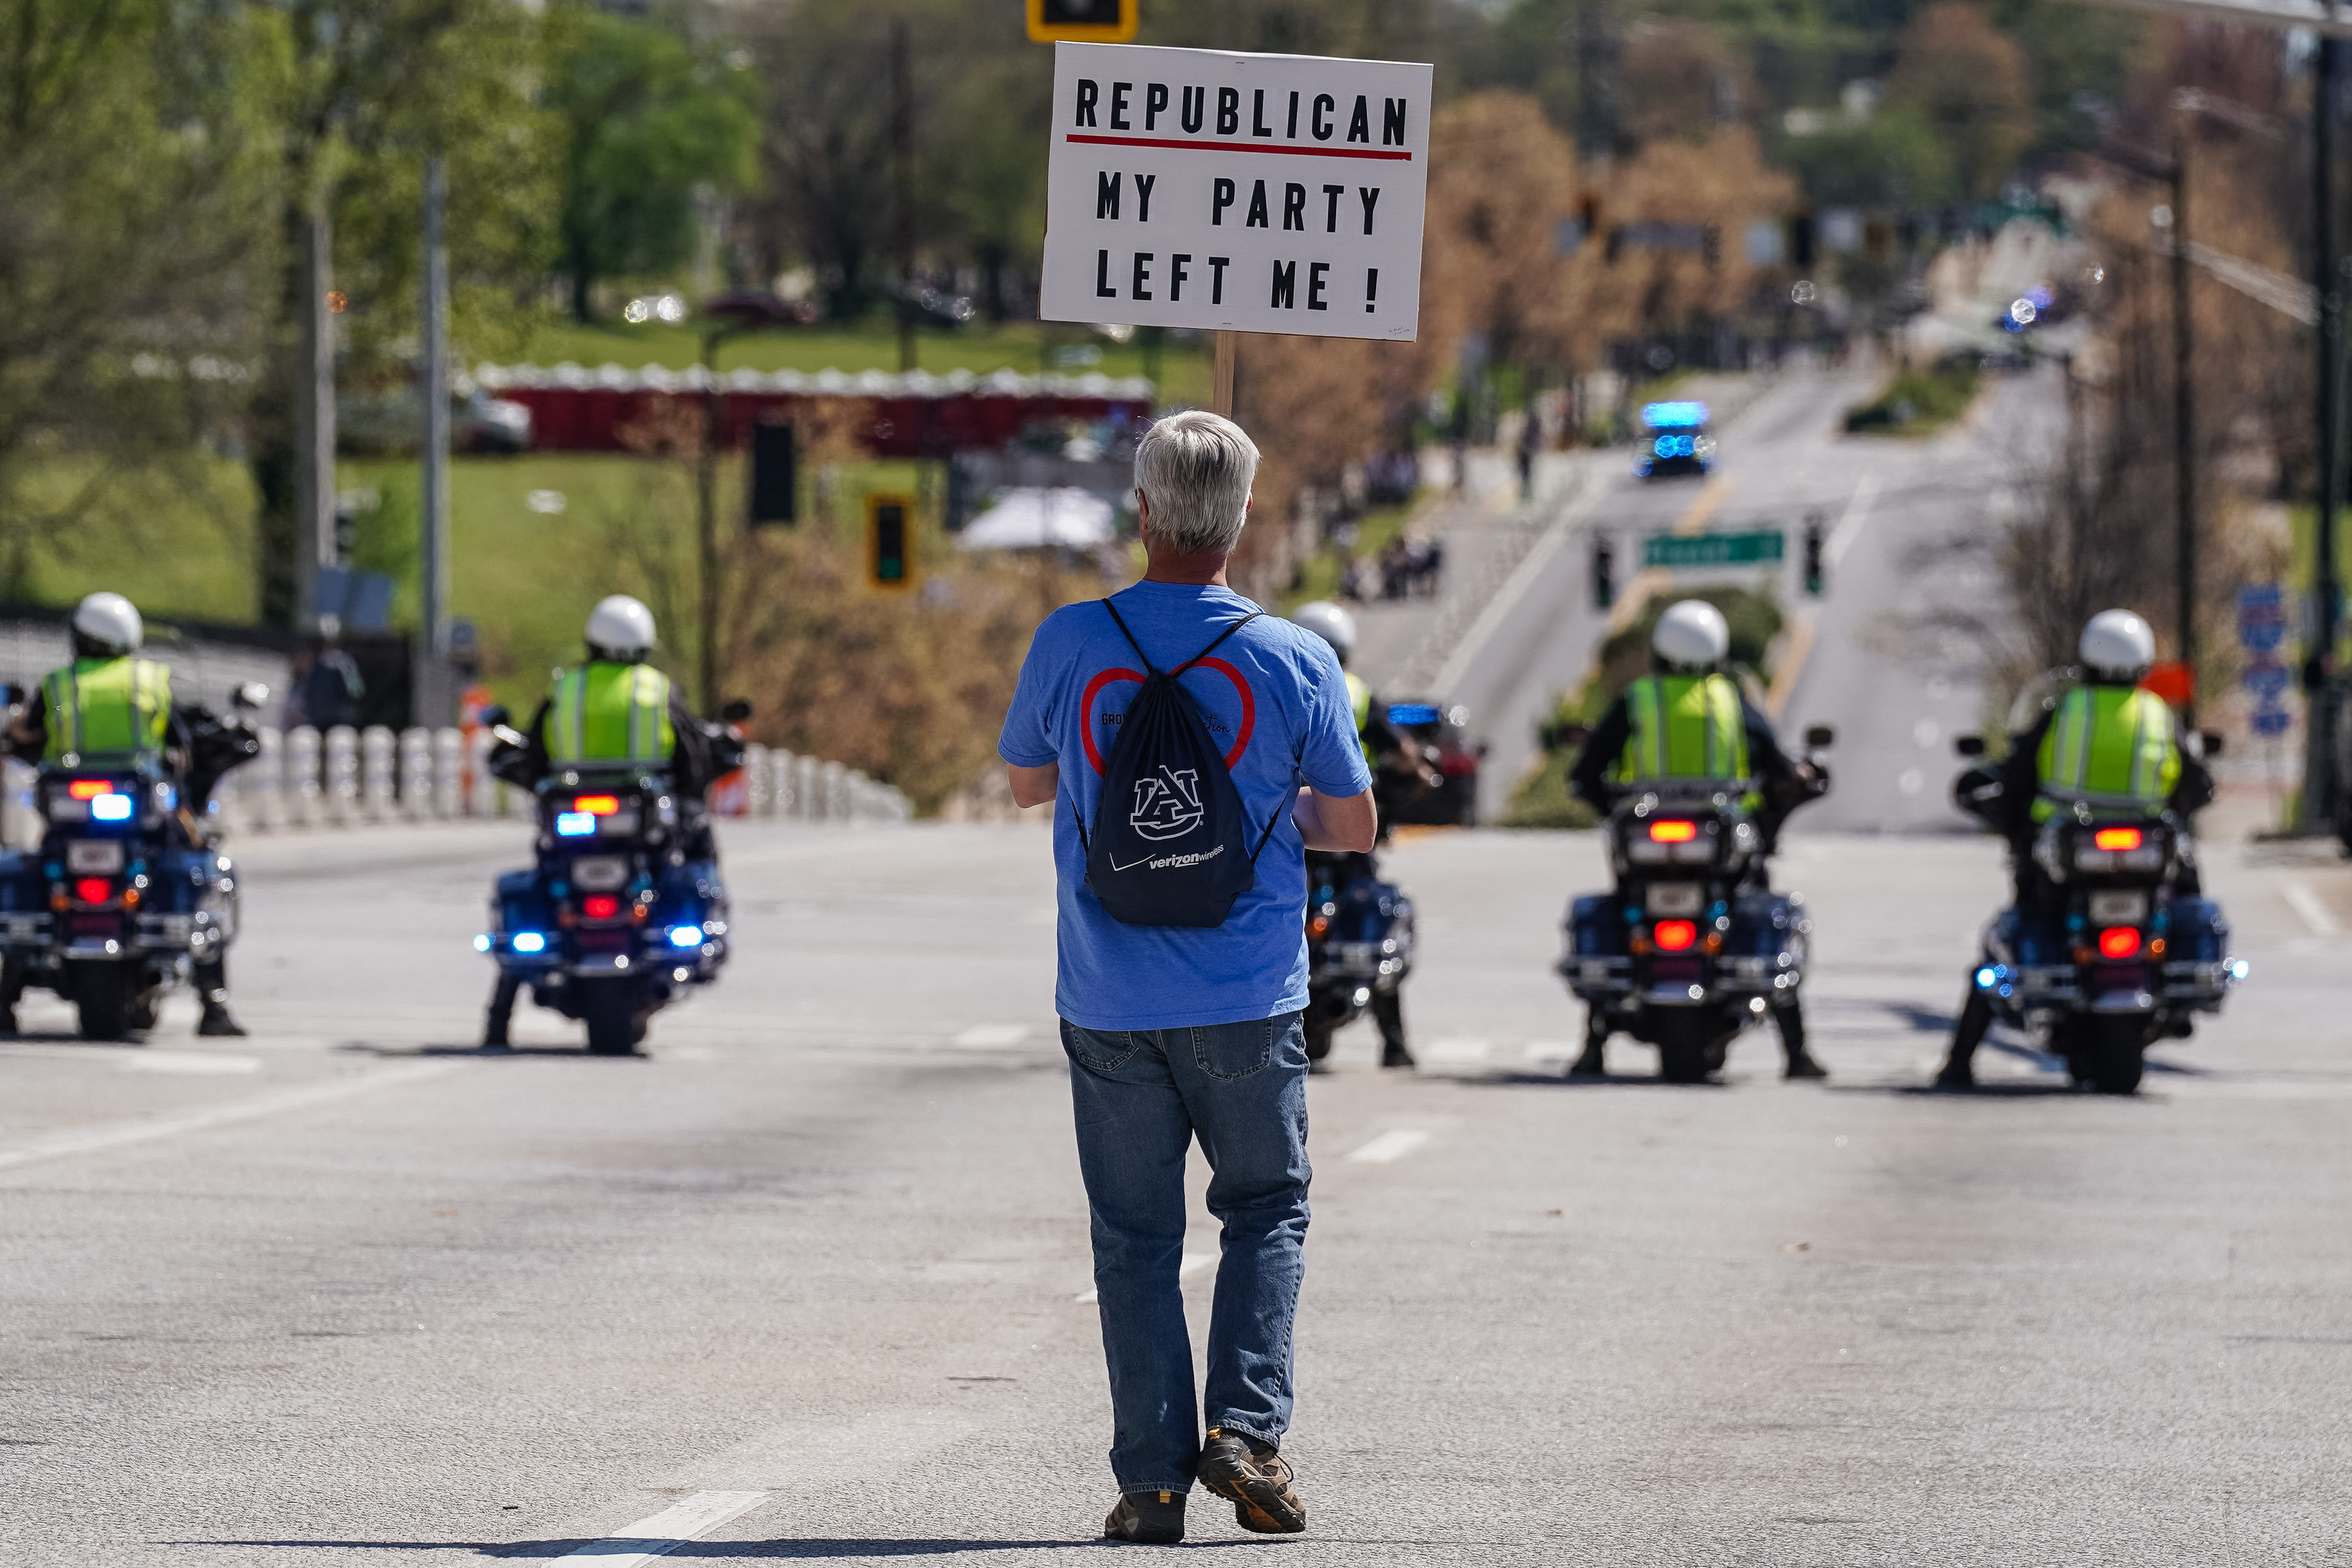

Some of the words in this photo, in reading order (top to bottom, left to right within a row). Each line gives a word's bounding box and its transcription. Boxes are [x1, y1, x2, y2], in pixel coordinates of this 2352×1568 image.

[1075, 79, 1406, 146] REPUBLICAN
[1096, 171, 1156, 222] MY
[1212, 178, 1381, 235] PARTY
[1096, 249, 1230, 305] LEFT
[1271, 260, 1330, 311] ME
